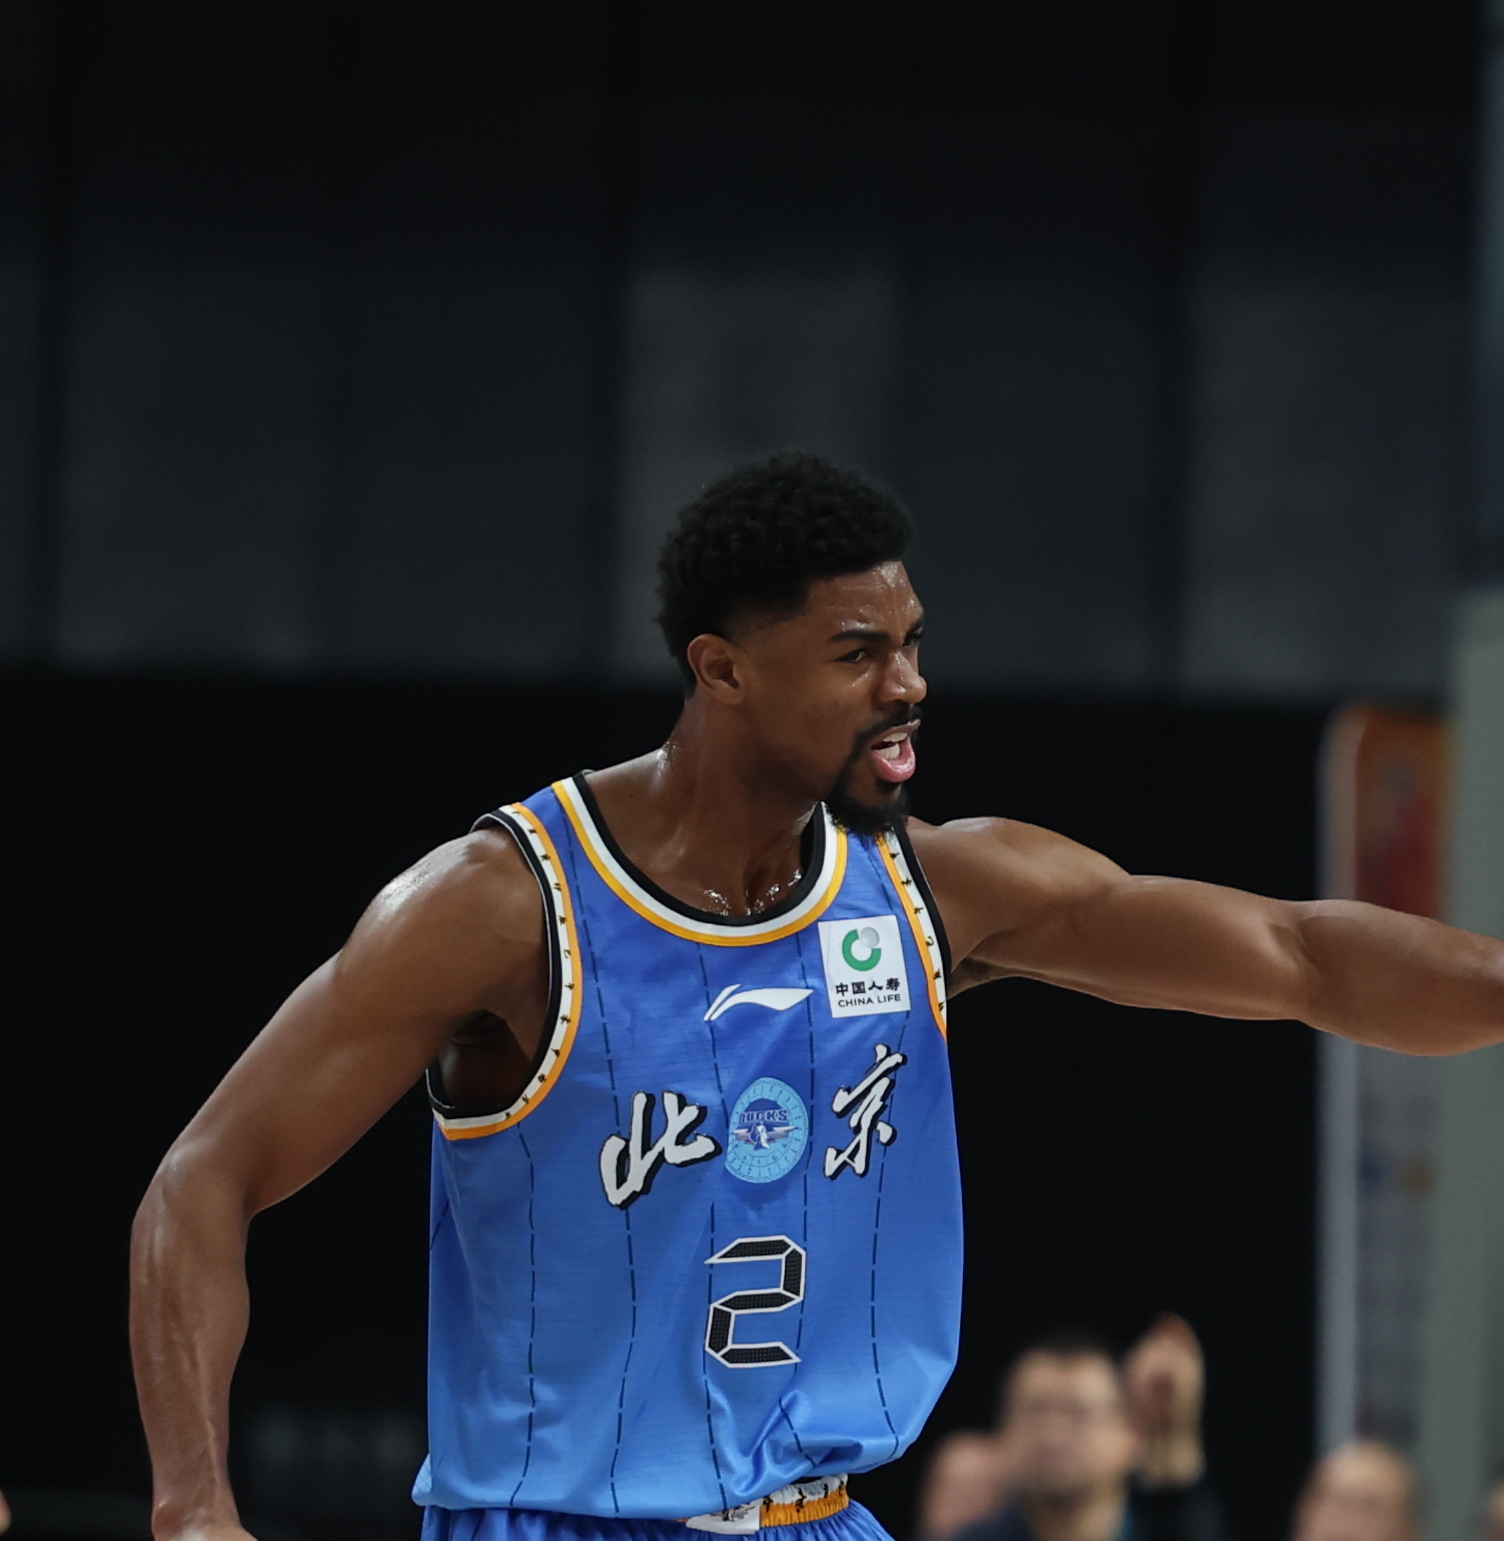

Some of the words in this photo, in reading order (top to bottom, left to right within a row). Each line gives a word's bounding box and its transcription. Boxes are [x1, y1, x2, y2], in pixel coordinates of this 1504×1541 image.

[835, 977, 900, 997] 中国人寿
[838, 997, 874, 1007] CHINA
[877, 994, 901, 1003] LIFE
[740, 1109, 790, 1124] DUCKS
[704, 1235, 806, 1369] 2
